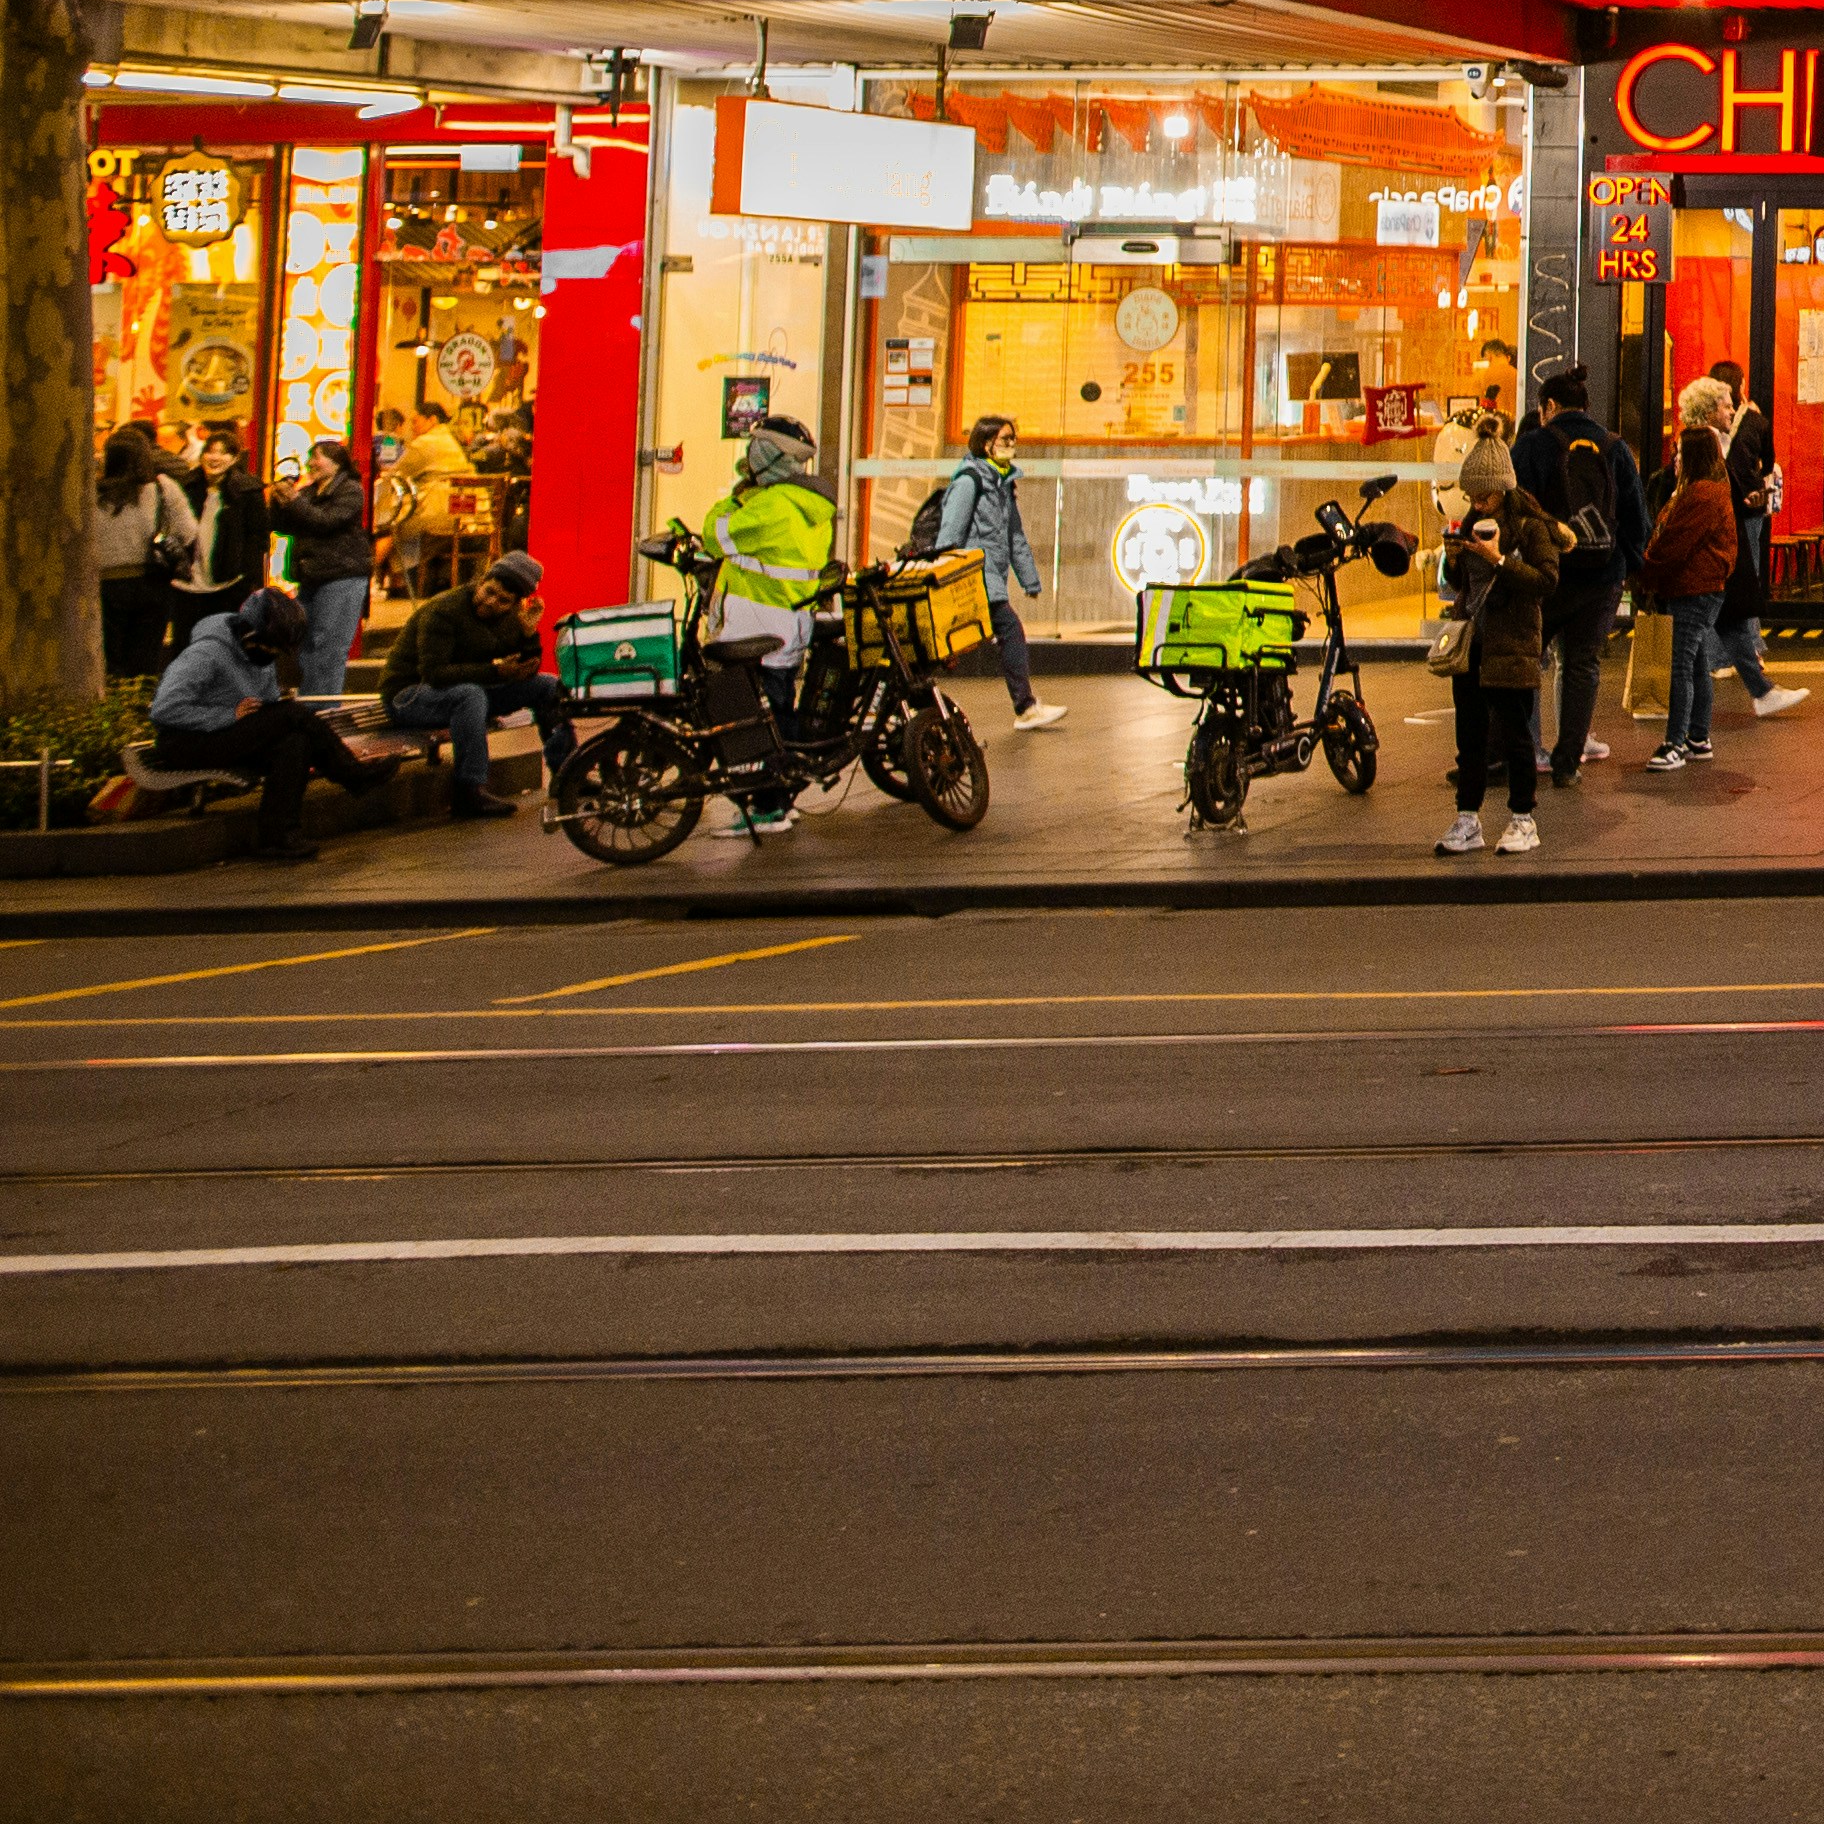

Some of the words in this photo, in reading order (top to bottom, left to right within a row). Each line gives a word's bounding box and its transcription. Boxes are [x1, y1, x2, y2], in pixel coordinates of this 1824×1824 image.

[87, 150, 140, 178] OT
[1588, 177, 1671, 207] OPEN
[1610, 214, 1649, 244] 24
[1599, 248, 1658, 280] HRS
[1123, 362, 1174, 385] 255
